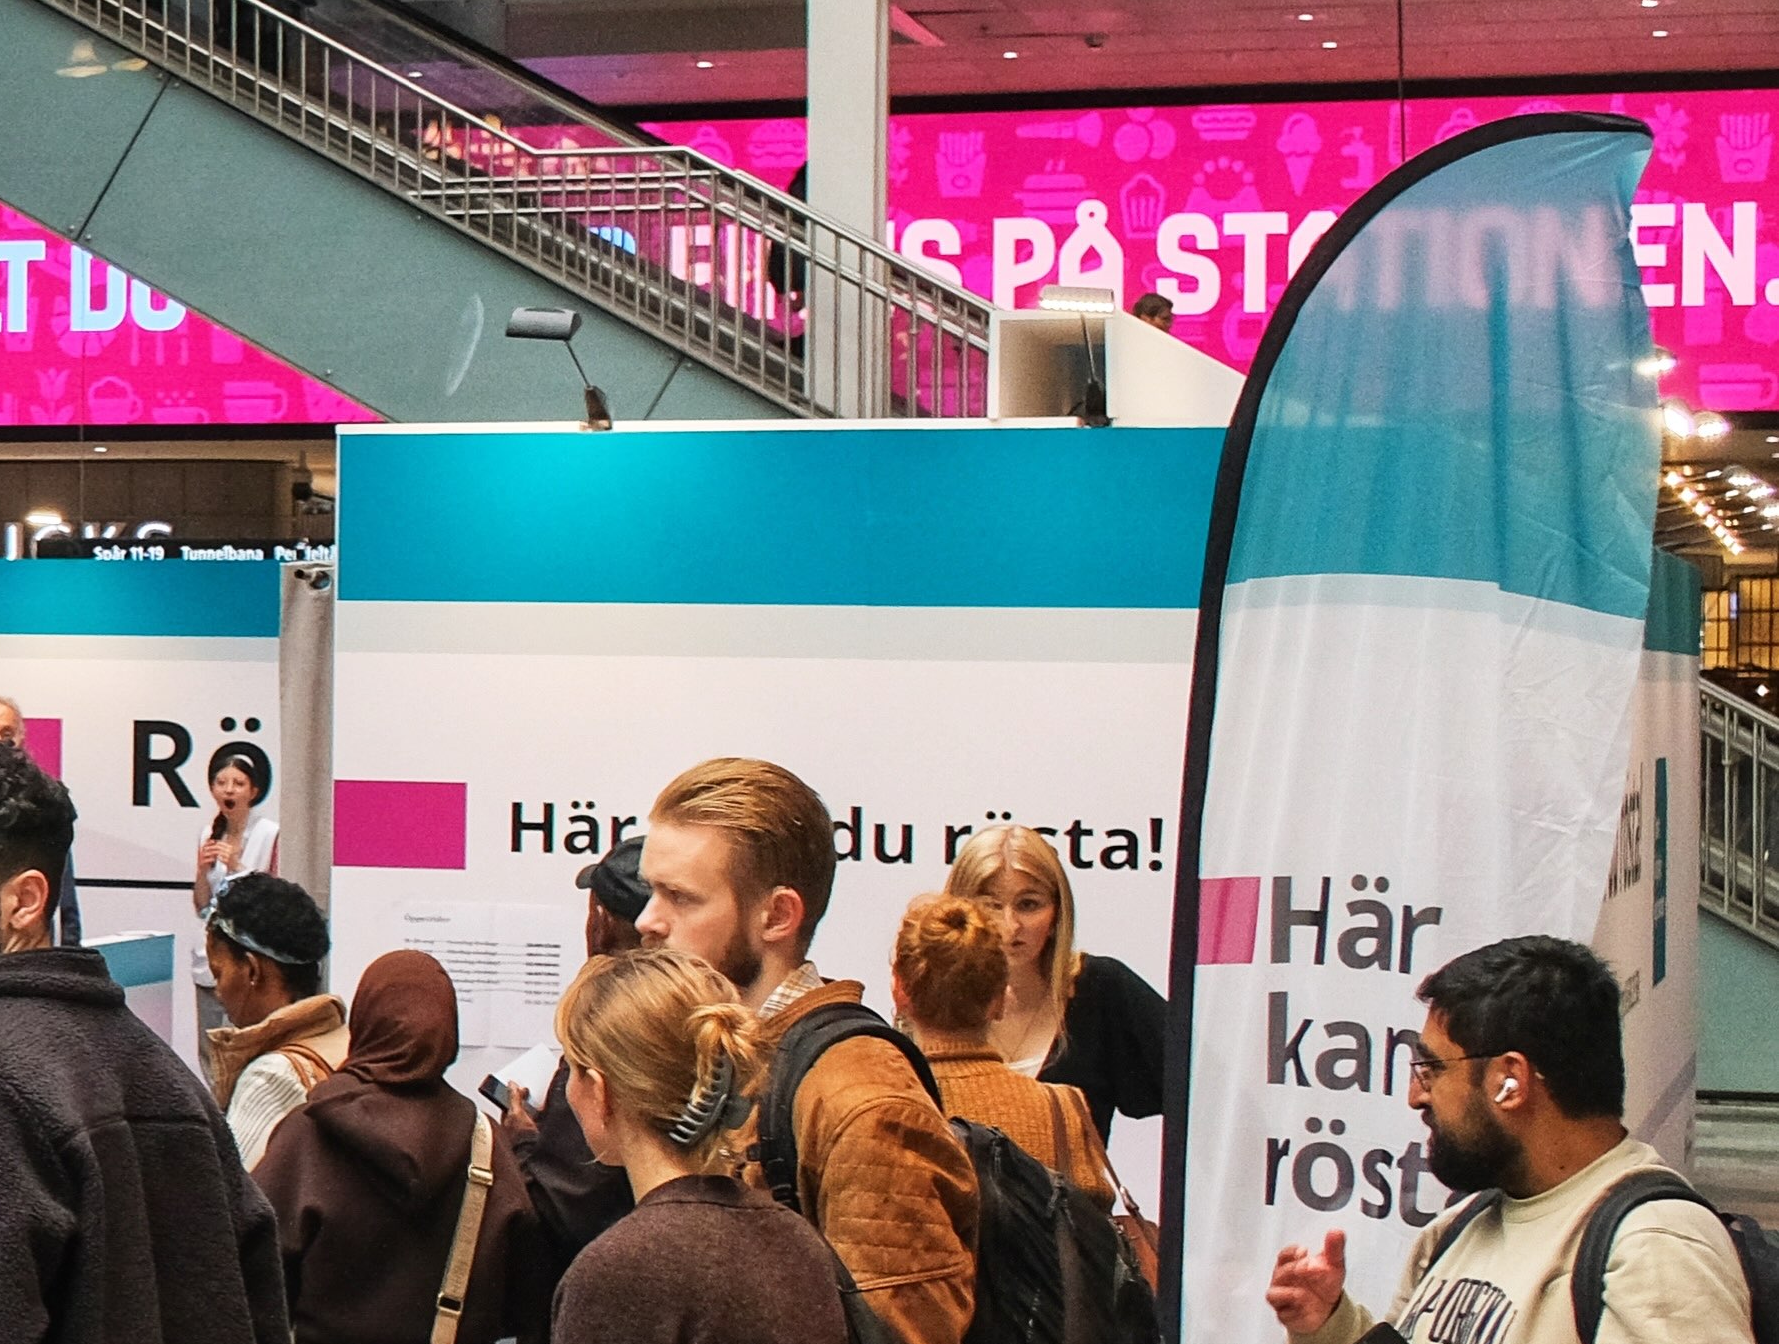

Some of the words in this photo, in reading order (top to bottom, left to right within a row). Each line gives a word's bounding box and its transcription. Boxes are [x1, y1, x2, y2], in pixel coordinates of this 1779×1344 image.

[993, 198, 1125, 311] PÅ
[510, 799, 637, 854] Här
[831, 805, 914, 864] du
[1270, 874, 1443, 974] Här
